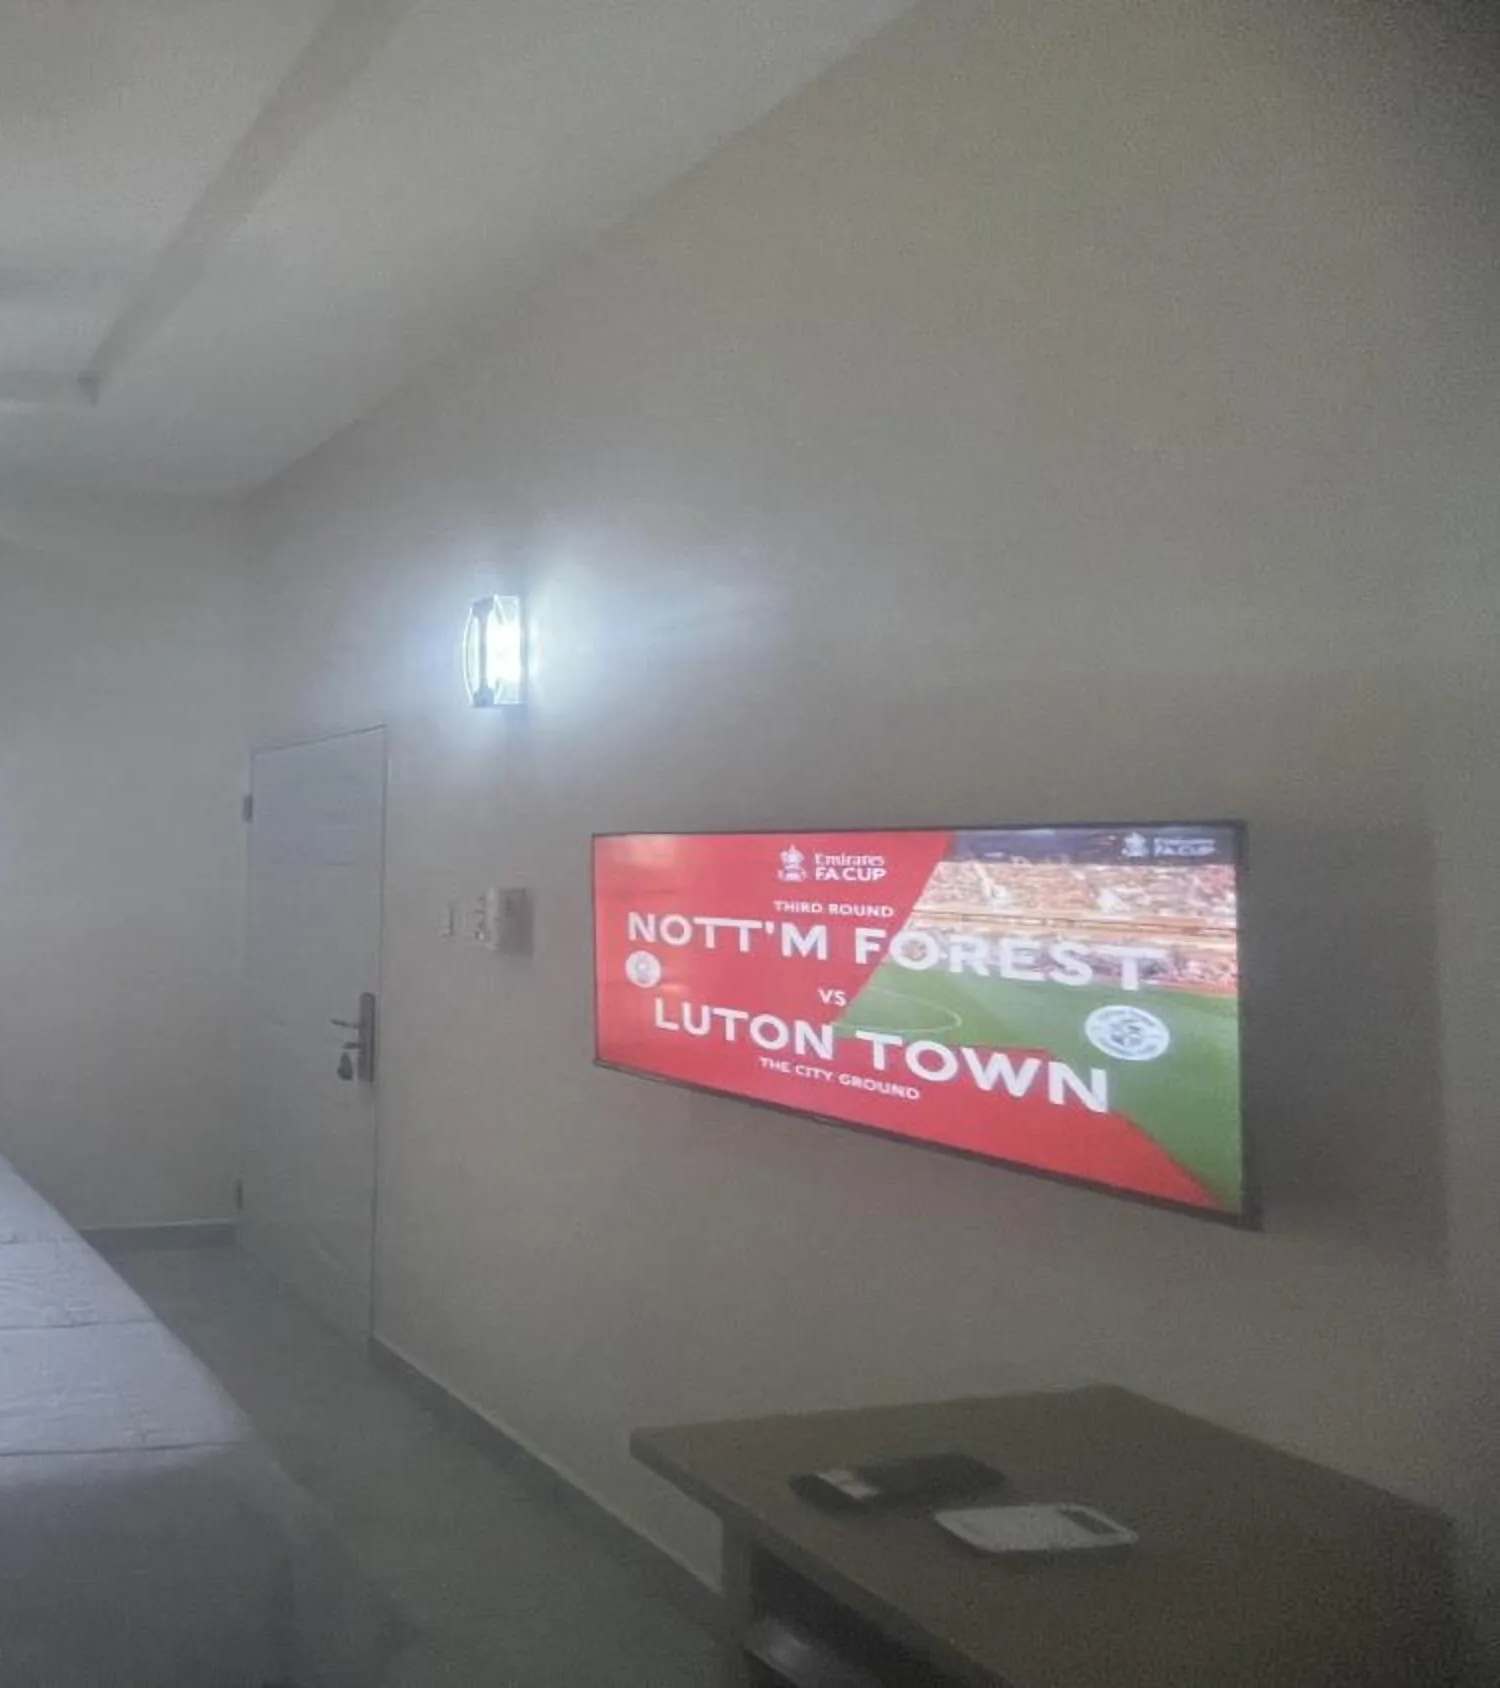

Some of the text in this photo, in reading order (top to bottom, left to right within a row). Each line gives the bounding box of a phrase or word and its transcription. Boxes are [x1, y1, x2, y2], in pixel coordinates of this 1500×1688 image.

[815, 853, 885, 866] Emirates
[815, 867, 887, 881] FA CUP
[774, 900, 895, 917] THIRD ROUND
[628, 911, 1169, 992] NOTT'M FOREST
[817, 988, 847, 1006] VS
[654, 997, 834, 1060] LUTON
[855, 1030, 1109, 1113] TOWN
[760, 1056, 921, 1100] THE CITY GROUND
